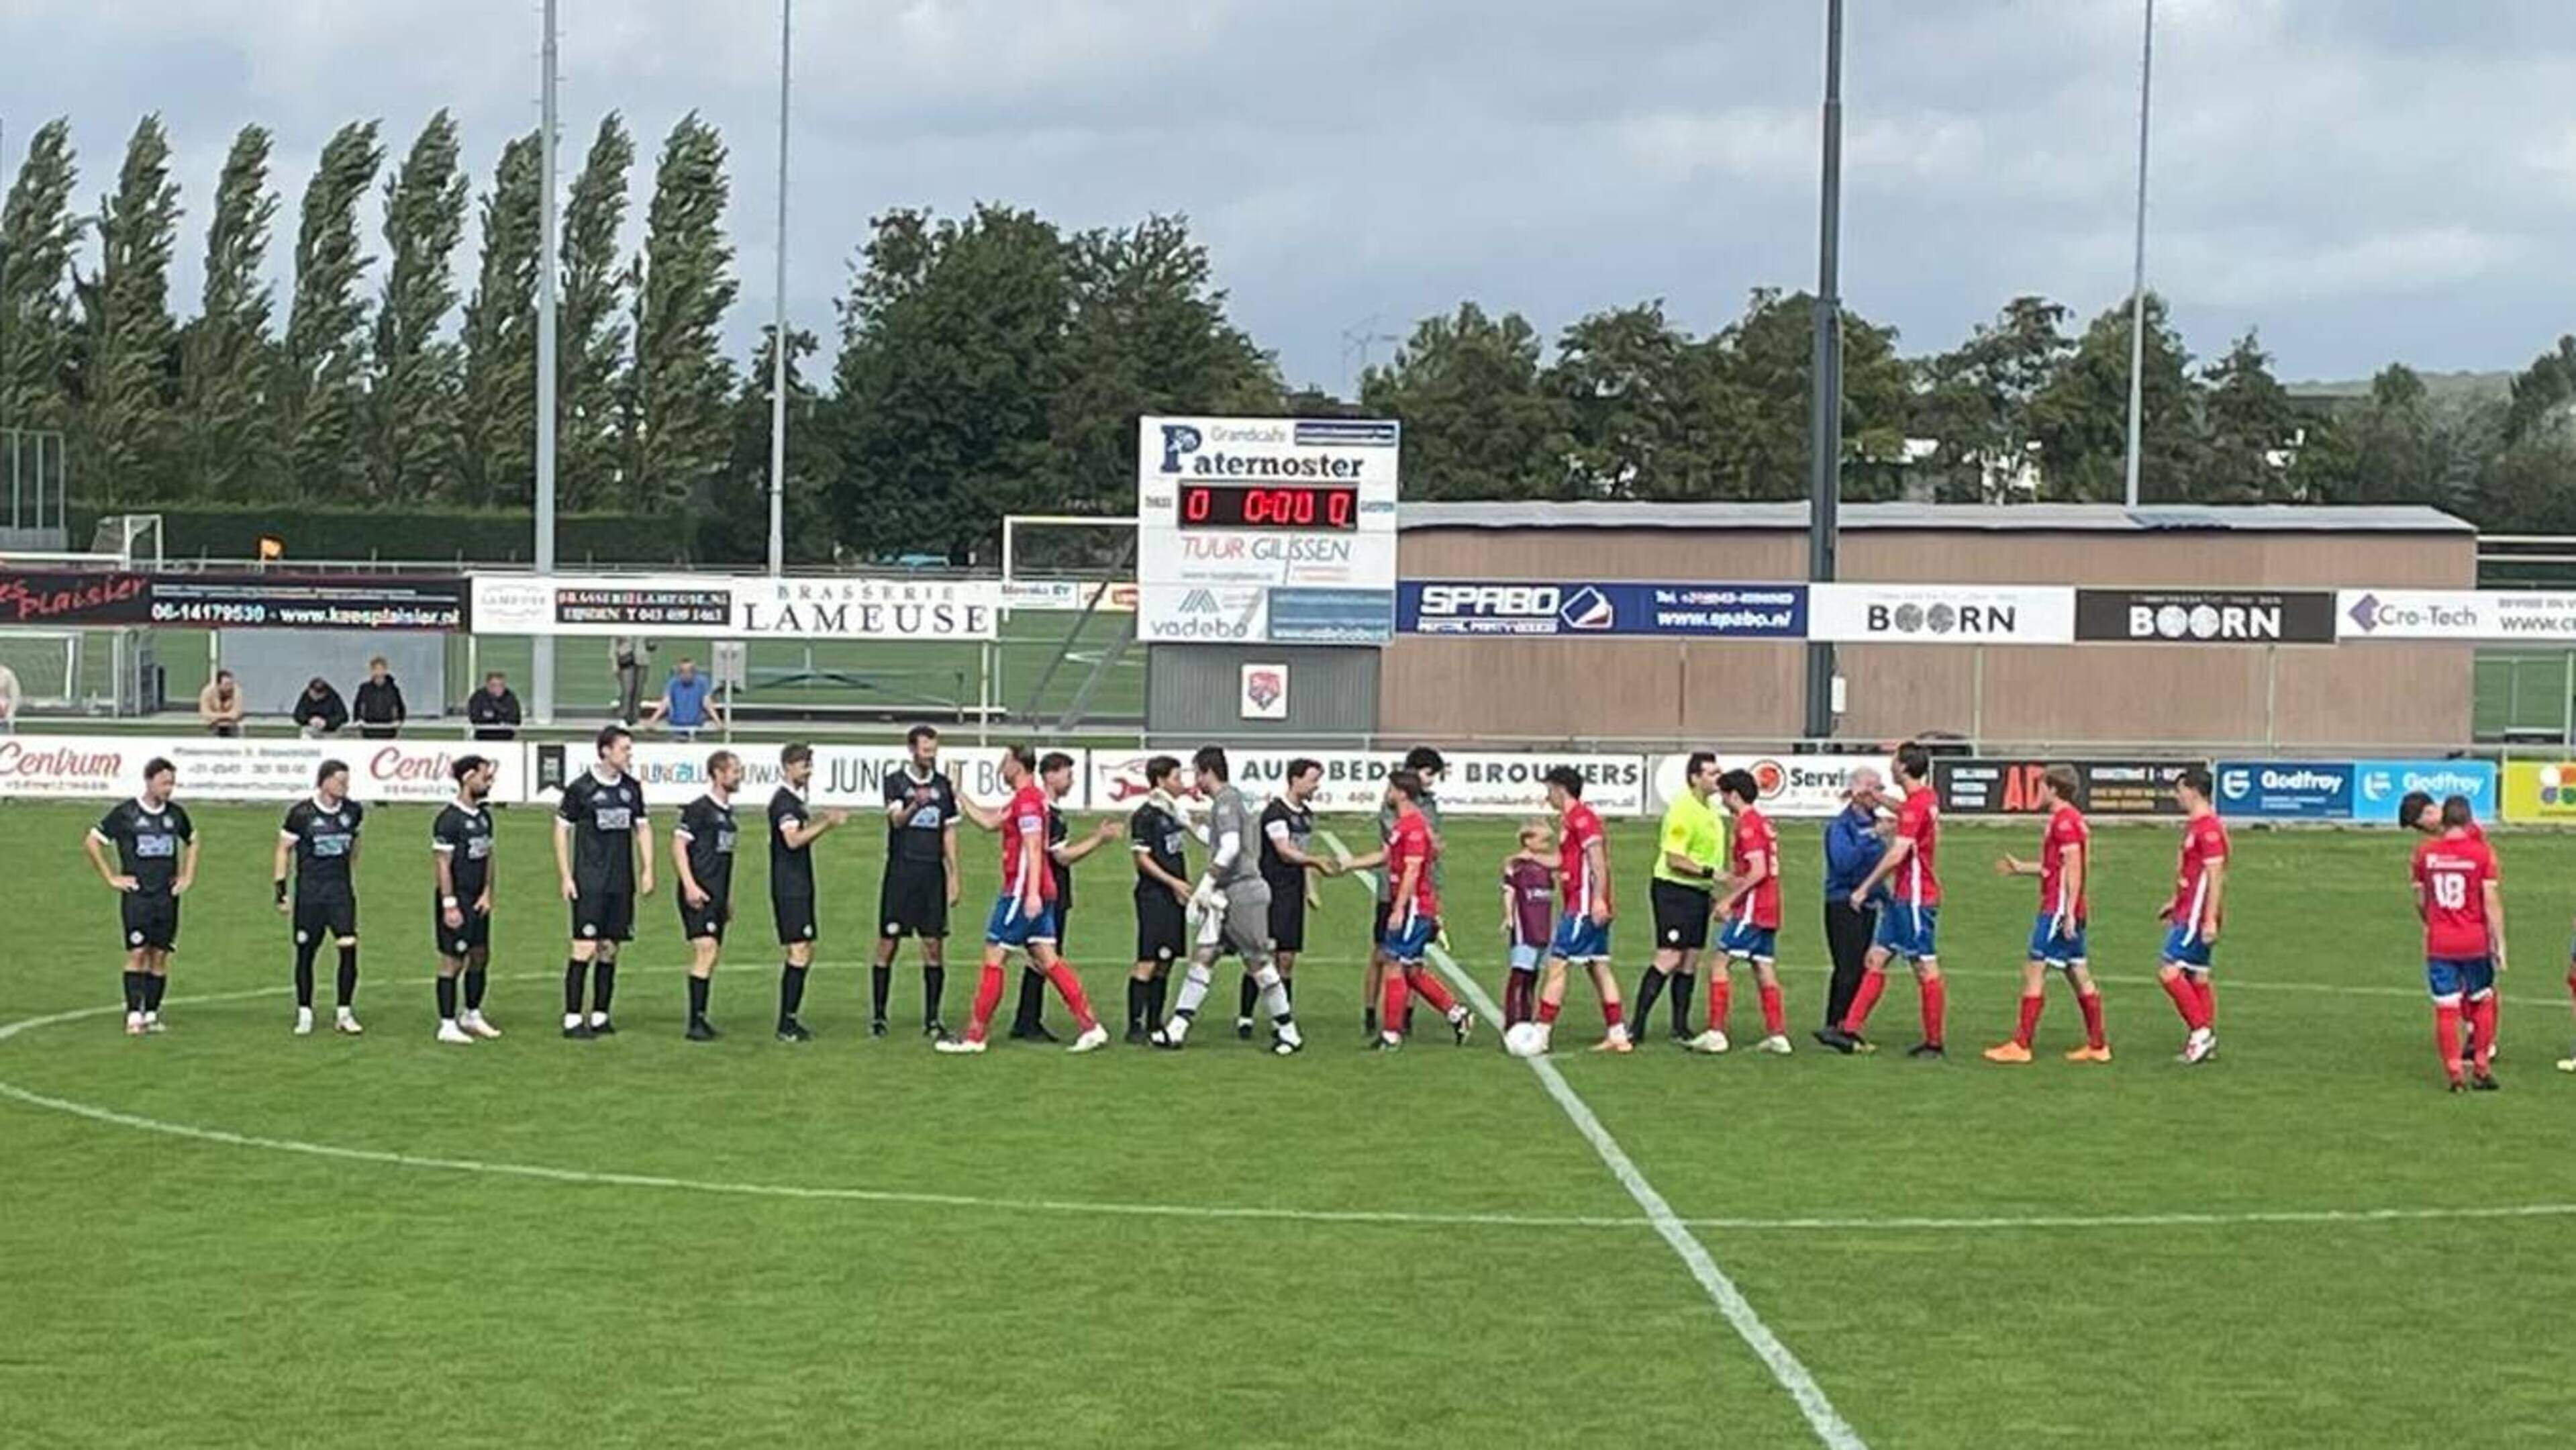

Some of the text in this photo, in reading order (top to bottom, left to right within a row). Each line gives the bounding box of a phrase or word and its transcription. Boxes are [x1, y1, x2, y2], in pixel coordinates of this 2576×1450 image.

[1160, 424, 1364, 477] Paternoster
[1187, 489, 1209, 521] 0
[1181, 536, 1244, 559] TUUR
[777, 585, 954, 601] BRASSERIE
[1420, 585, 1560, 615] SPABO
[152, 603, 265, 623] 06-14179530
[280, 607, 460, 627] www.keesplaisier.nl
[742, 603, 989, 633] LAMEUSE
[1657, 610, 1792, 630] www.spabo.nl
[1867, 602, 2016, 634] BOORN
[2129, 603, 2281, 638] BOORN
[2378, 605, 2478, 626] Cro-Tech
[1150, 617, 1248, 638] vadebo
[0, 741, 121, 777] Centrum
[1466, 762, 1638, 785] BROUERS
[2261, 770, 2343, 794] Godfroy
